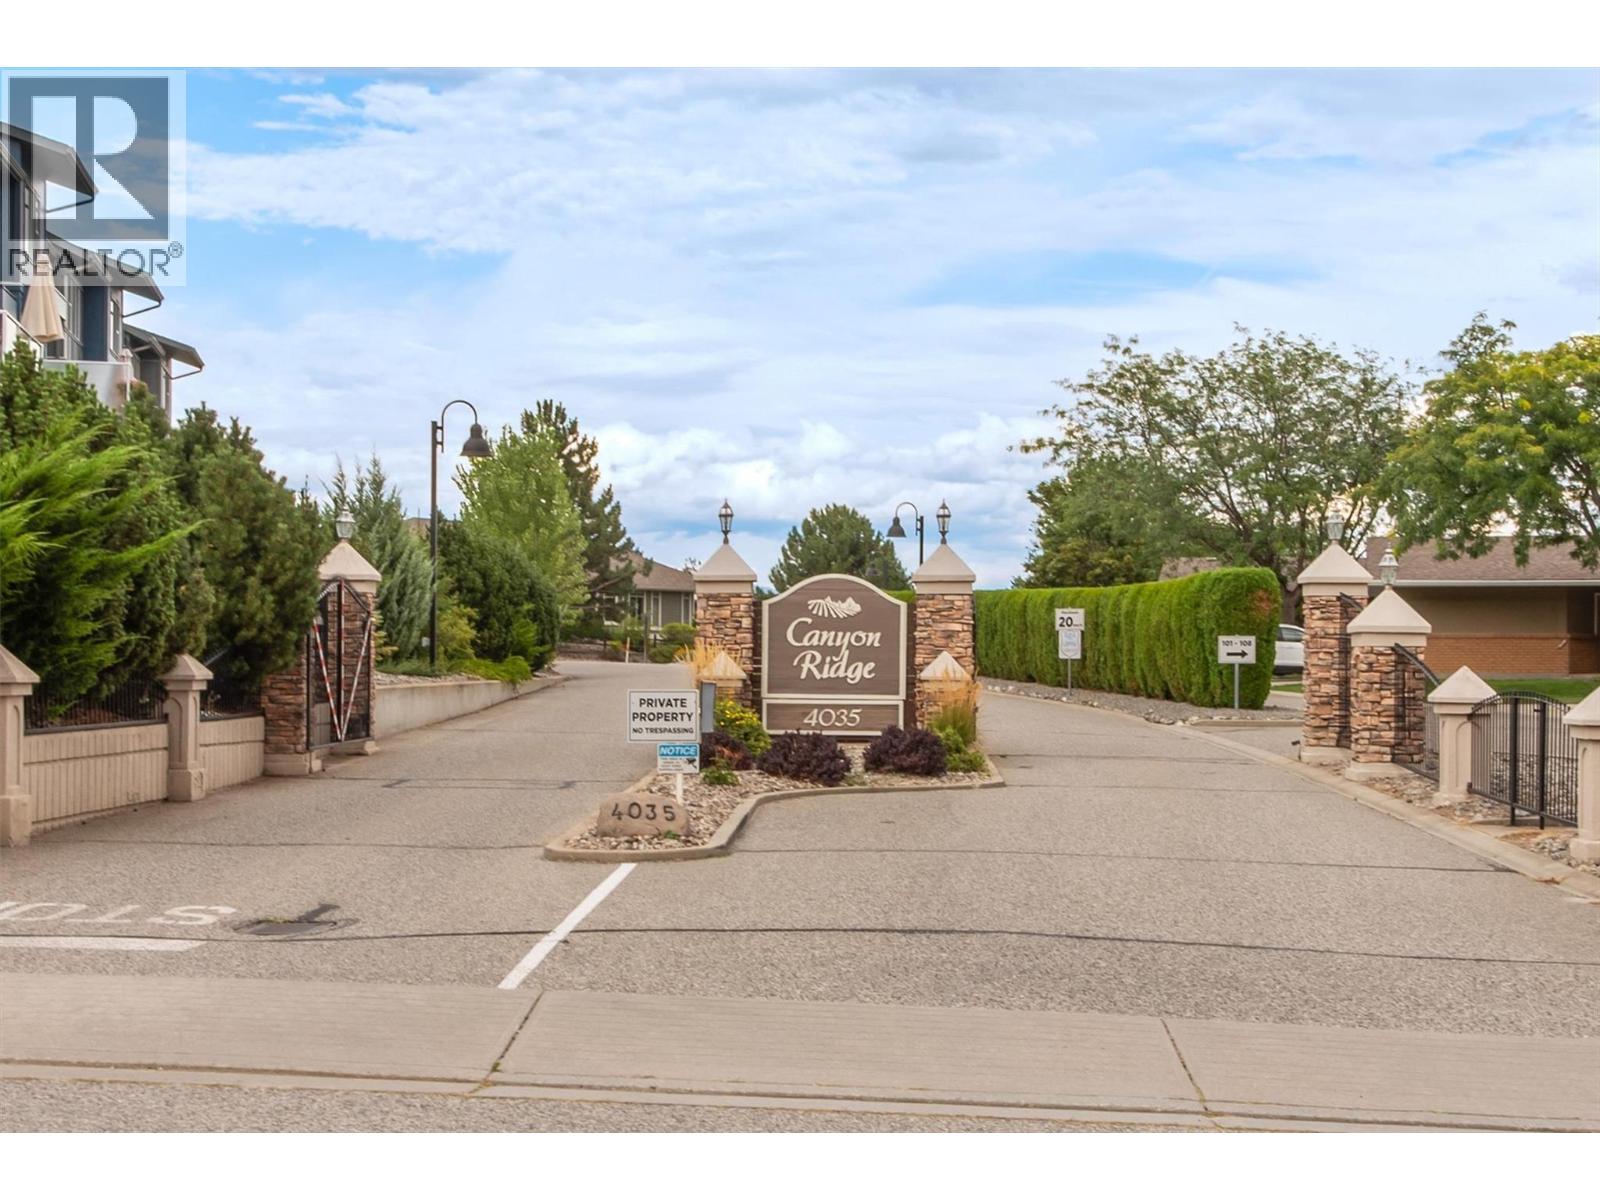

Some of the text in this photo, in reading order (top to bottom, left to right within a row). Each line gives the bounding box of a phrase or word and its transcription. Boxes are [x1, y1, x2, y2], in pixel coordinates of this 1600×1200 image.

[1058, 616, 1074, 628] 20
[786, 617, 882, 661] Canyon
[793, 649, 876, 684] Ridge
[639, 698, 687, 708] PRIVATE
[632, 712, 694, 722] PROPERTY
[803, 708, 862, 726] 4035
[660, 746, 697, 755] NOTICE
[611, 802, 677, 822] 4035
[0, 901, 237, 925] STO
